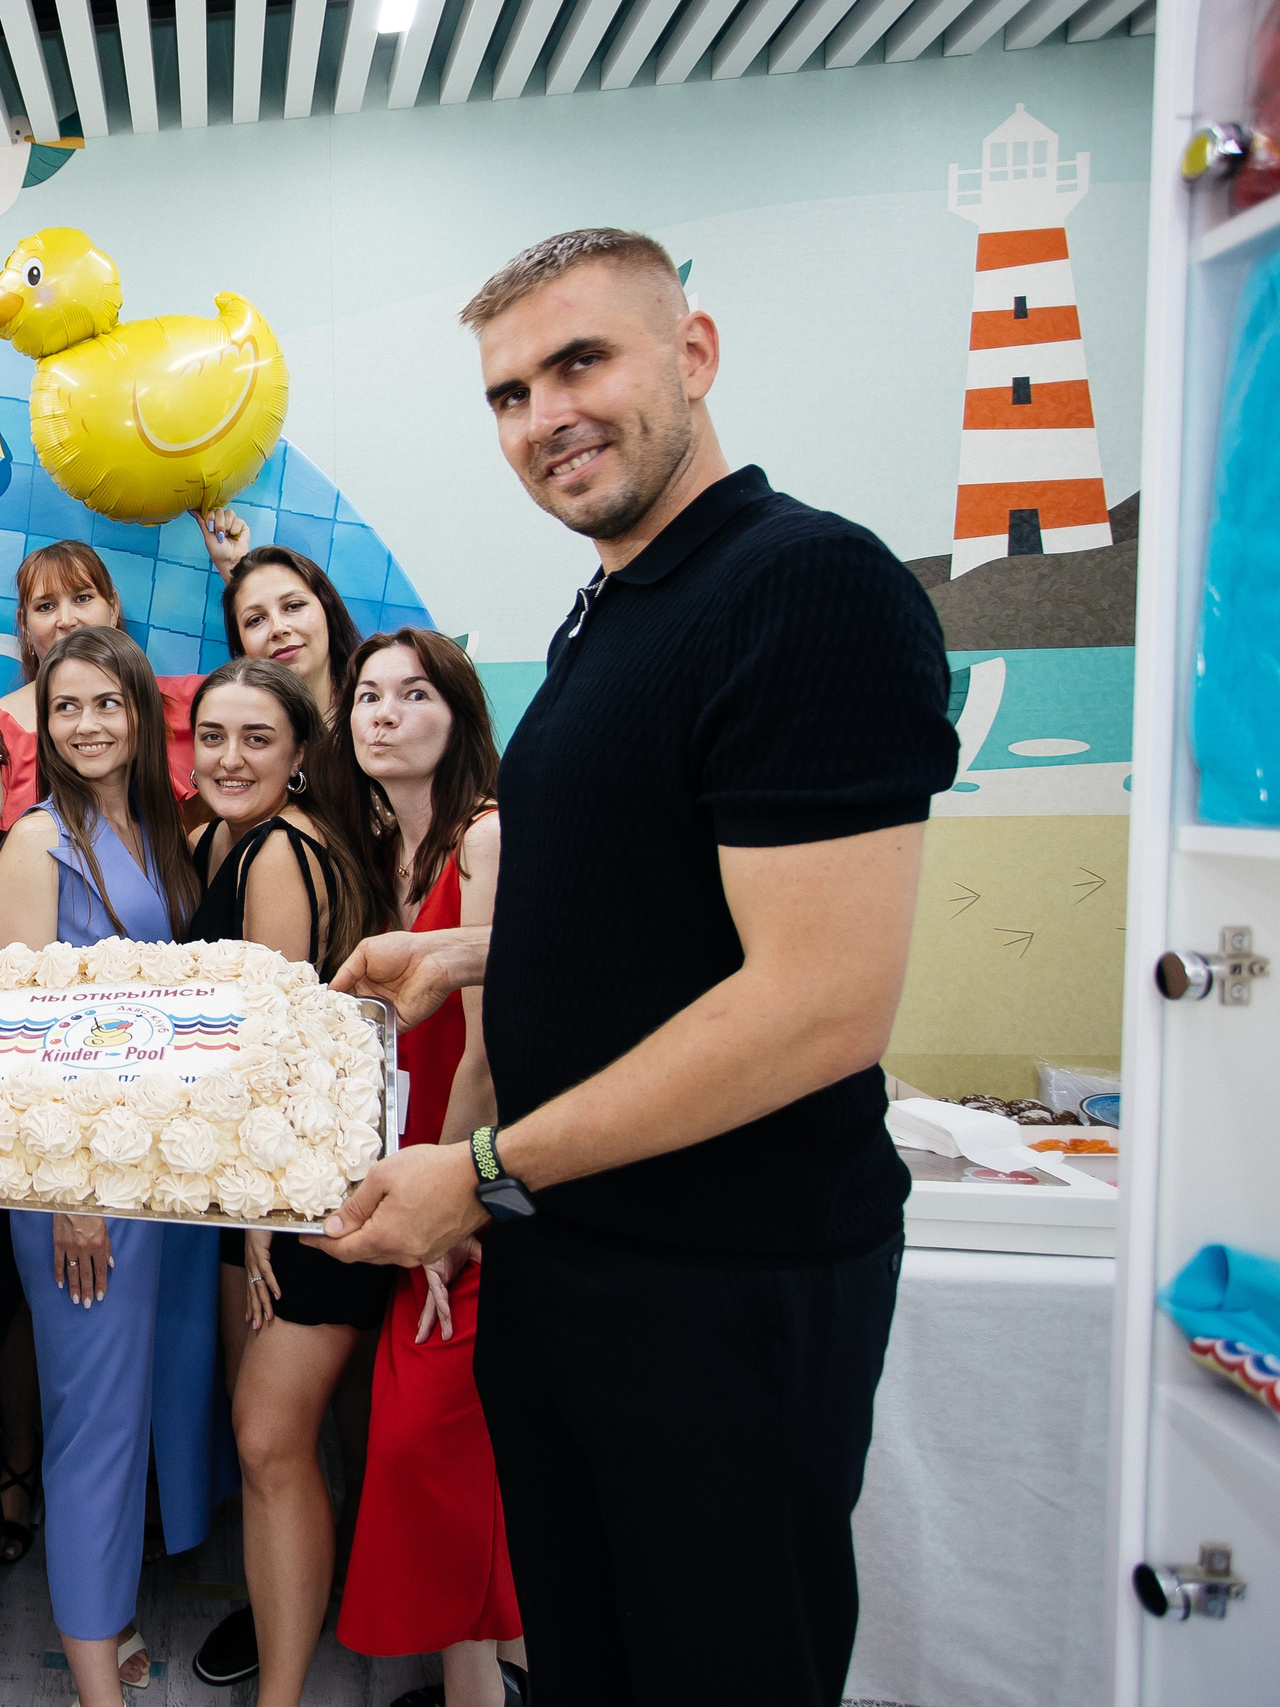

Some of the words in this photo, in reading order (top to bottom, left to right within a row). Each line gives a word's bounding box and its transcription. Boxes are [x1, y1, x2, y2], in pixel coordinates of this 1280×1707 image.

[30, 994, 67, 1003] МЫ
[72, 988, 215, 1001] ОТКРЫЛИСЬ!
[116, 1005, 170, 1034] Аква-клуб
[41, 1047, 102, 1062] Kinder
[124, 1046, 166, 1060] Pool
